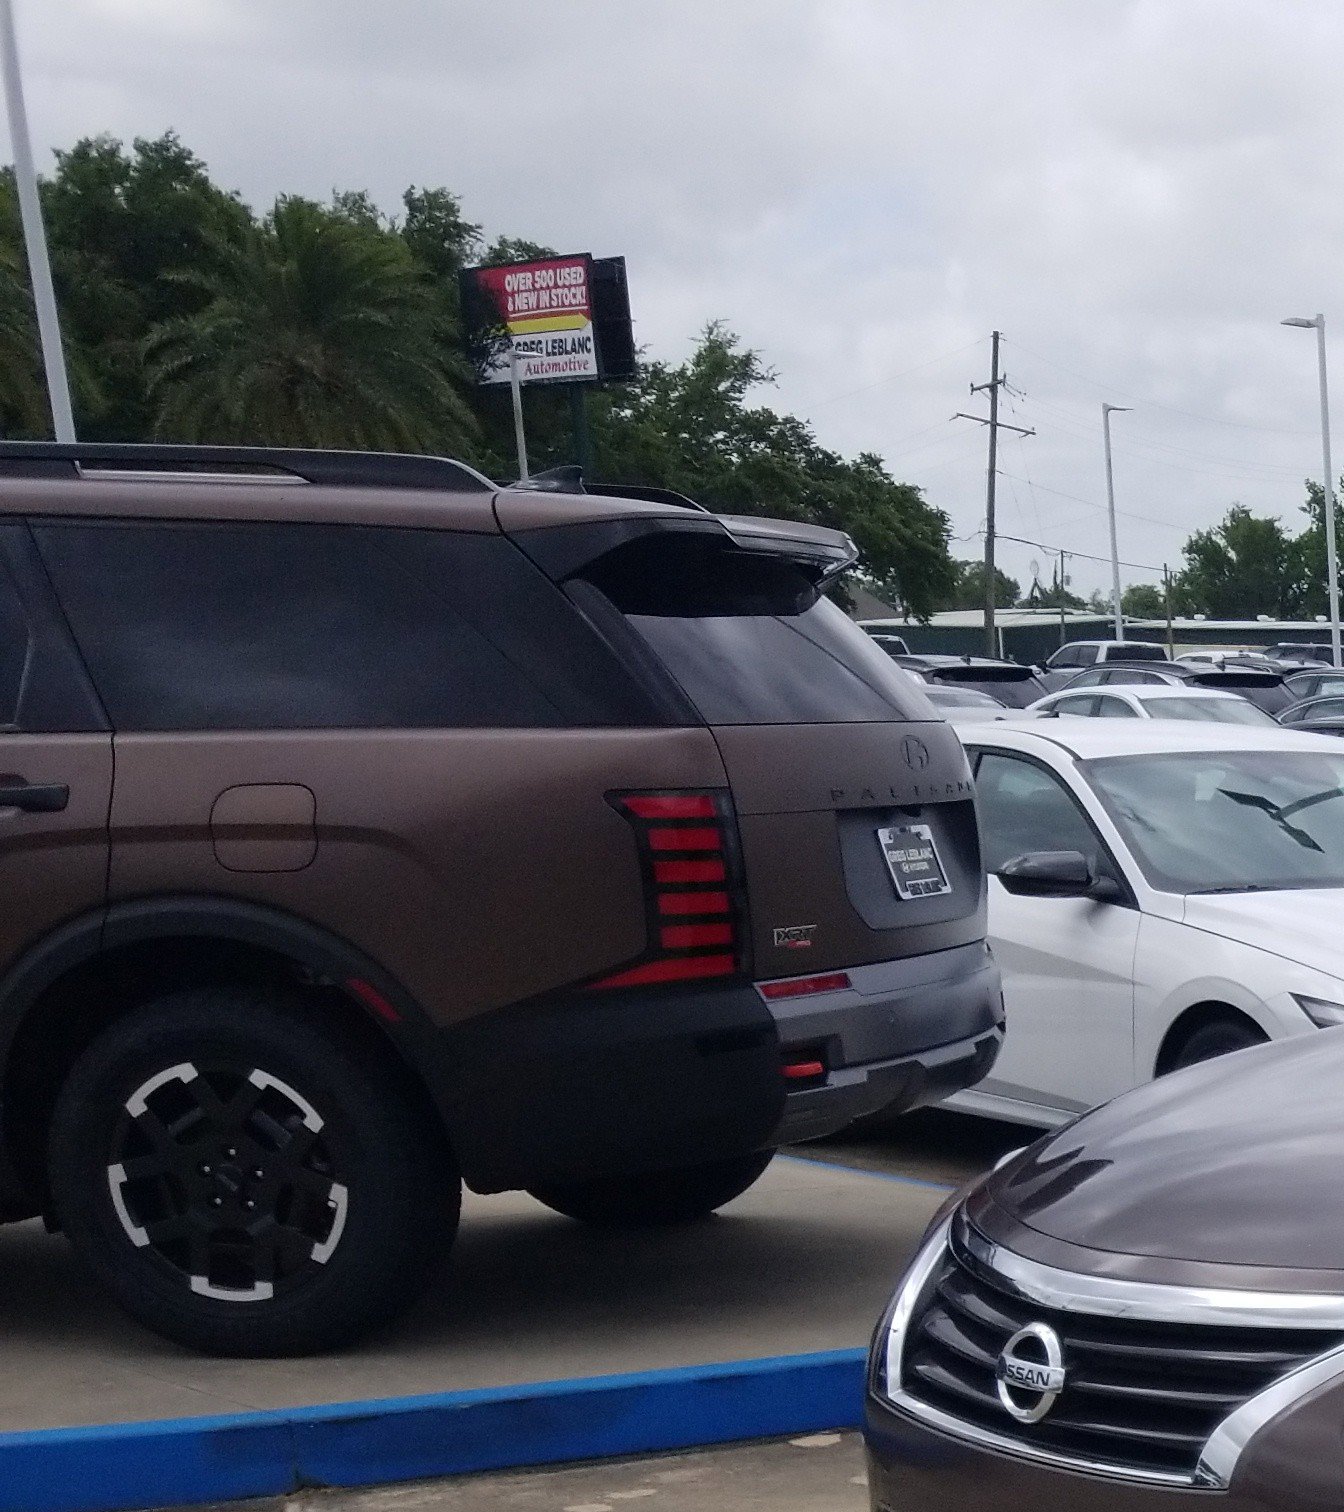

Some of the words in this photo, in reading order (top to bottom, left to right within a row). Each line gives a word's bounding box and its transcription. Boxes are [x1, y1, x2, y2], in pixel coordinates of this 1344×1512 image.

[505, 272, 533, 293] OVER
[535, 269, 554, 289] 500
[557, 266, 585, 286] USED
[515, 292, 538, 311] NEW
[539, 290, 550, 308] IN
[551, 286, 586, 307] STOCK!
[545, 336, 592, 357] LEBLANC
[525, 356, 589, 376] Automotive
[1003, 1362, 1050, 1387] SSAN
